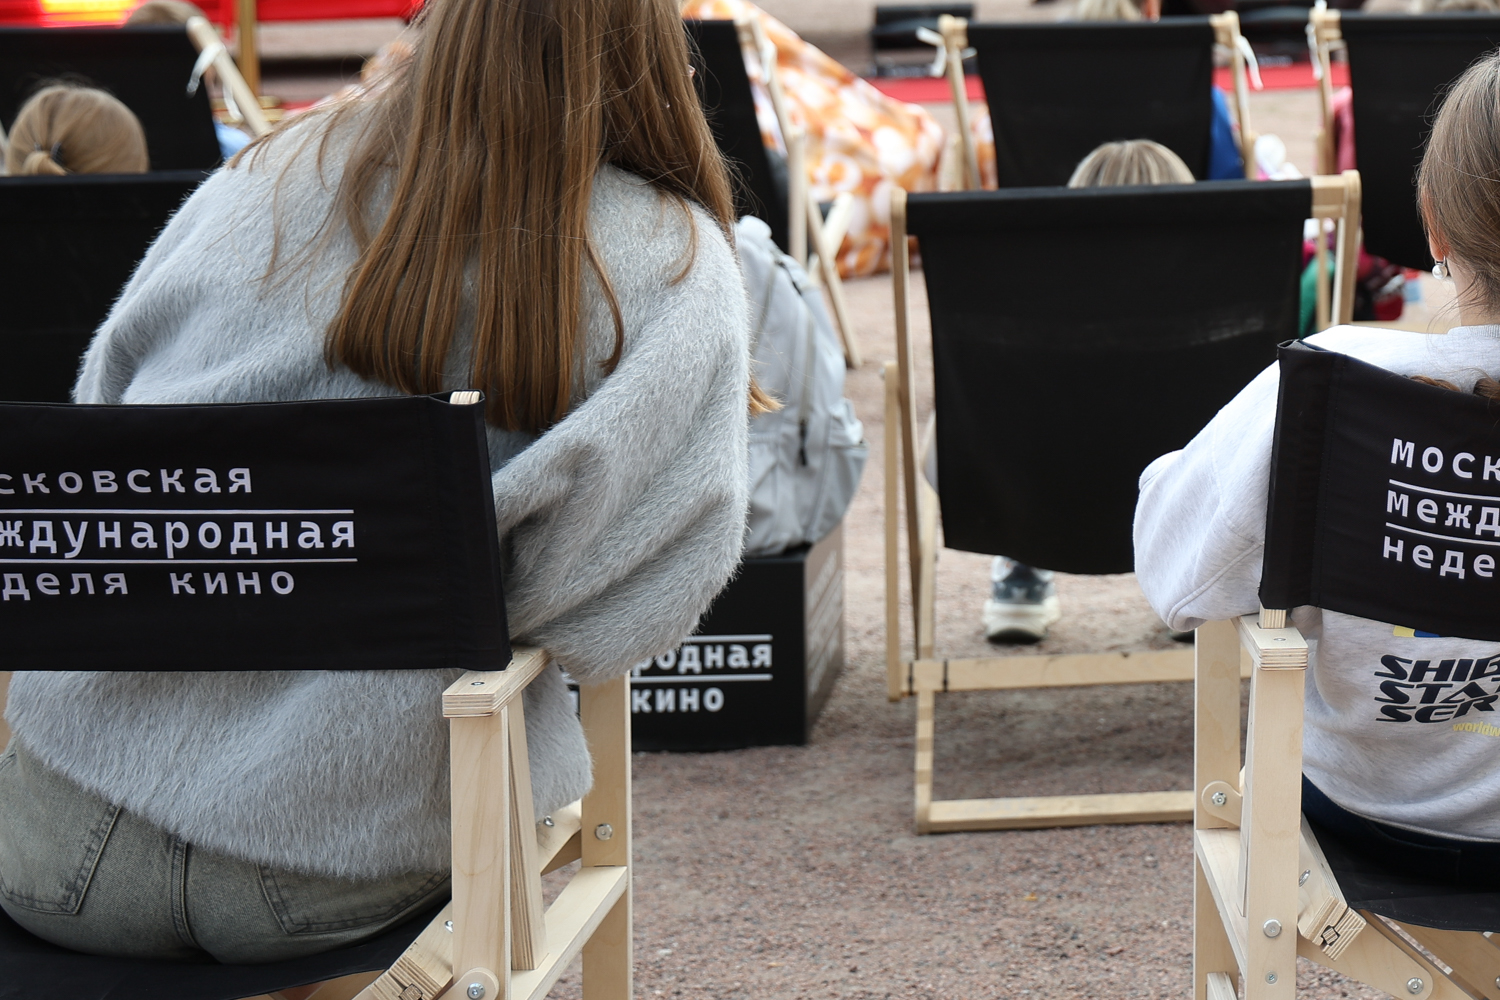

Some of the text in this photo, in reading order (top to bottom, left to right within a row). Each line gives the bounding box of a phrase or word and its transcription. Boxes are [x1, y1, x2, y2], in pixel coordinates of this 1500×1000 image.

[0, 467, 253, 495] сковская
[0, 519, 355, 559] ждународная
[2, 569, 296, 601] деля кино
[631, 687, 725, 714] кино
